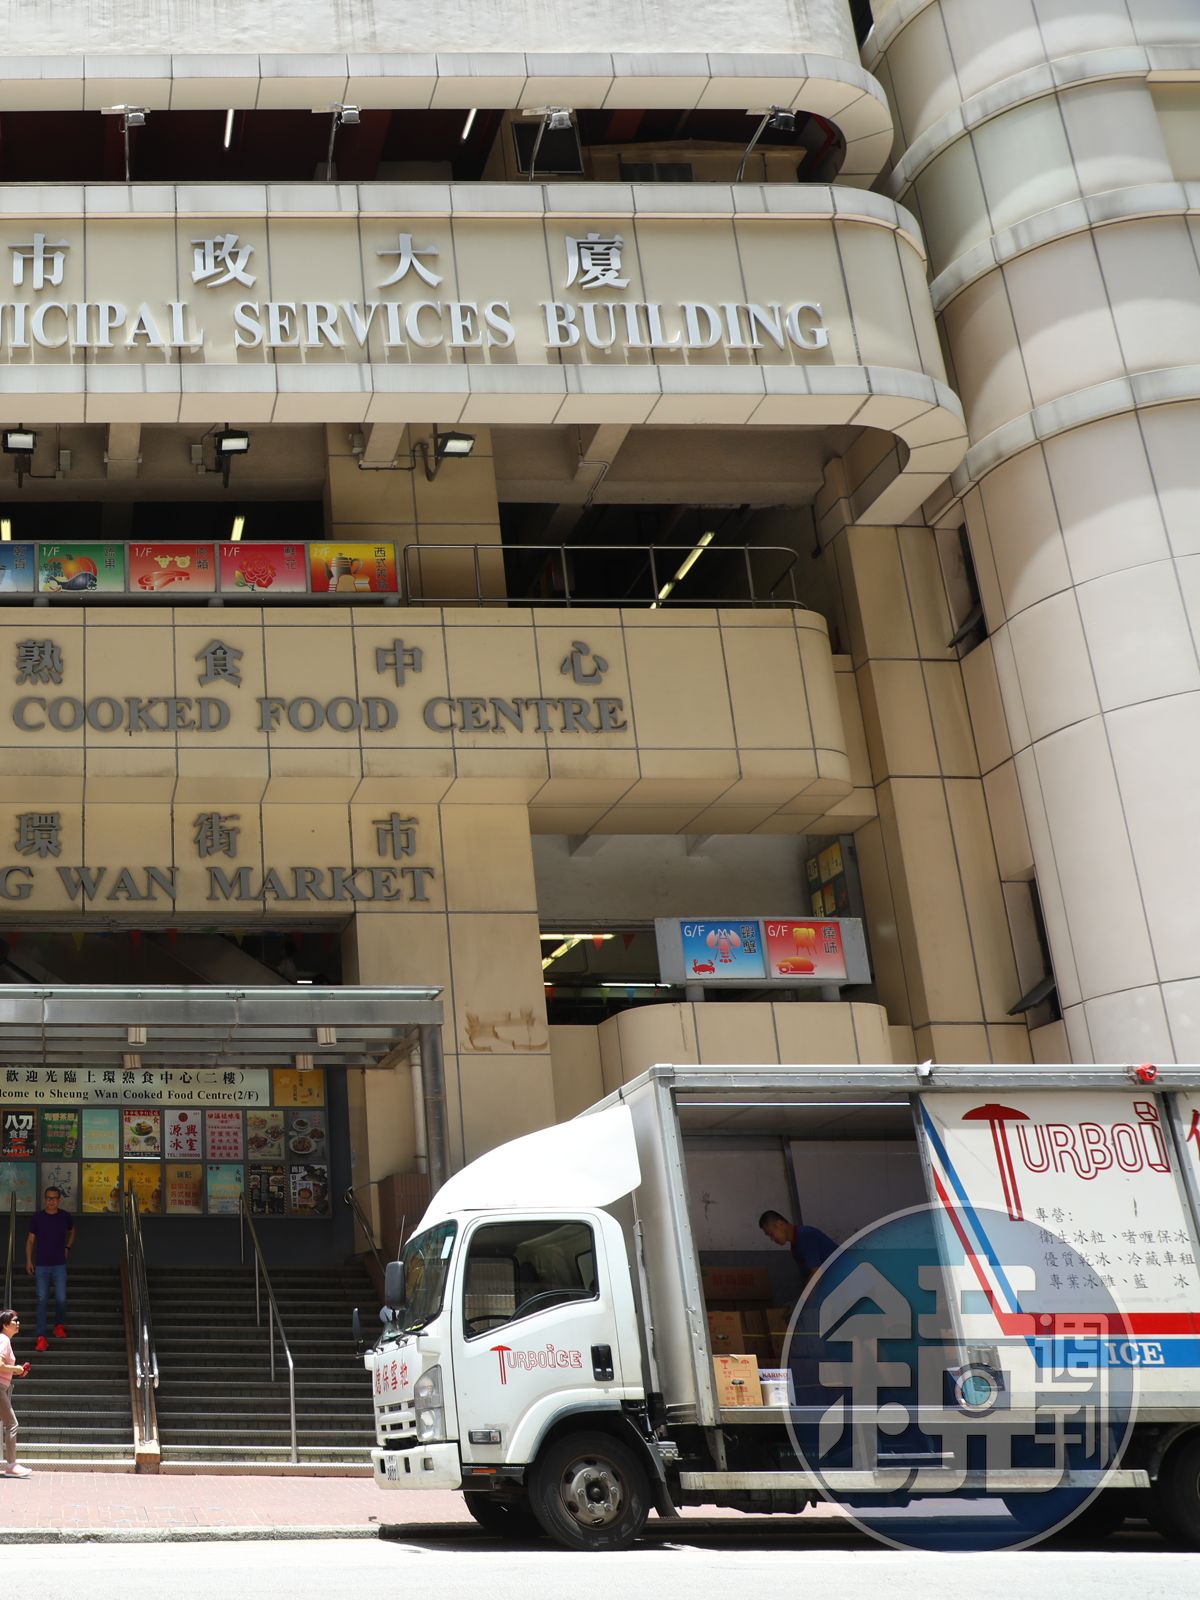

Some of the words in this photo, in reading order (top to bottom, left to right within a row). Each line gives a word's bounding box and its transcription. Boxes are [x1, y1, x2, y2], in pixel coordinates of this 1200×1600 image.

[233, 302, 515, 349] SERVICES
[540, 302, 829, 350] BUILDING
[42, 546, 60, 557] 1/F
[134, 546, 152, 557] 1/F
[223, 546, 240, 557] 1/F
[12, 697, 231, 733] COOKED
[256, 697, 399, 733] FOOD
[422, 697, 629, 734] CENTRE
[56, 865, 179, 901] WAN
[206, 866, 435, 902] MARKET
[683, 924, 706, 938] G/F
[767, 924, 789, 938] G/F
[34, 1088, 45, 1099] to
[49, 1088, 89, 1101] Sheung
[94, 1088, 119, 1100] Wan
[123, 1089, 163, 1100] Cooked
[167, 1089, 194, 1101] Food
[1103, 1342, 1166, 1365] ICE
